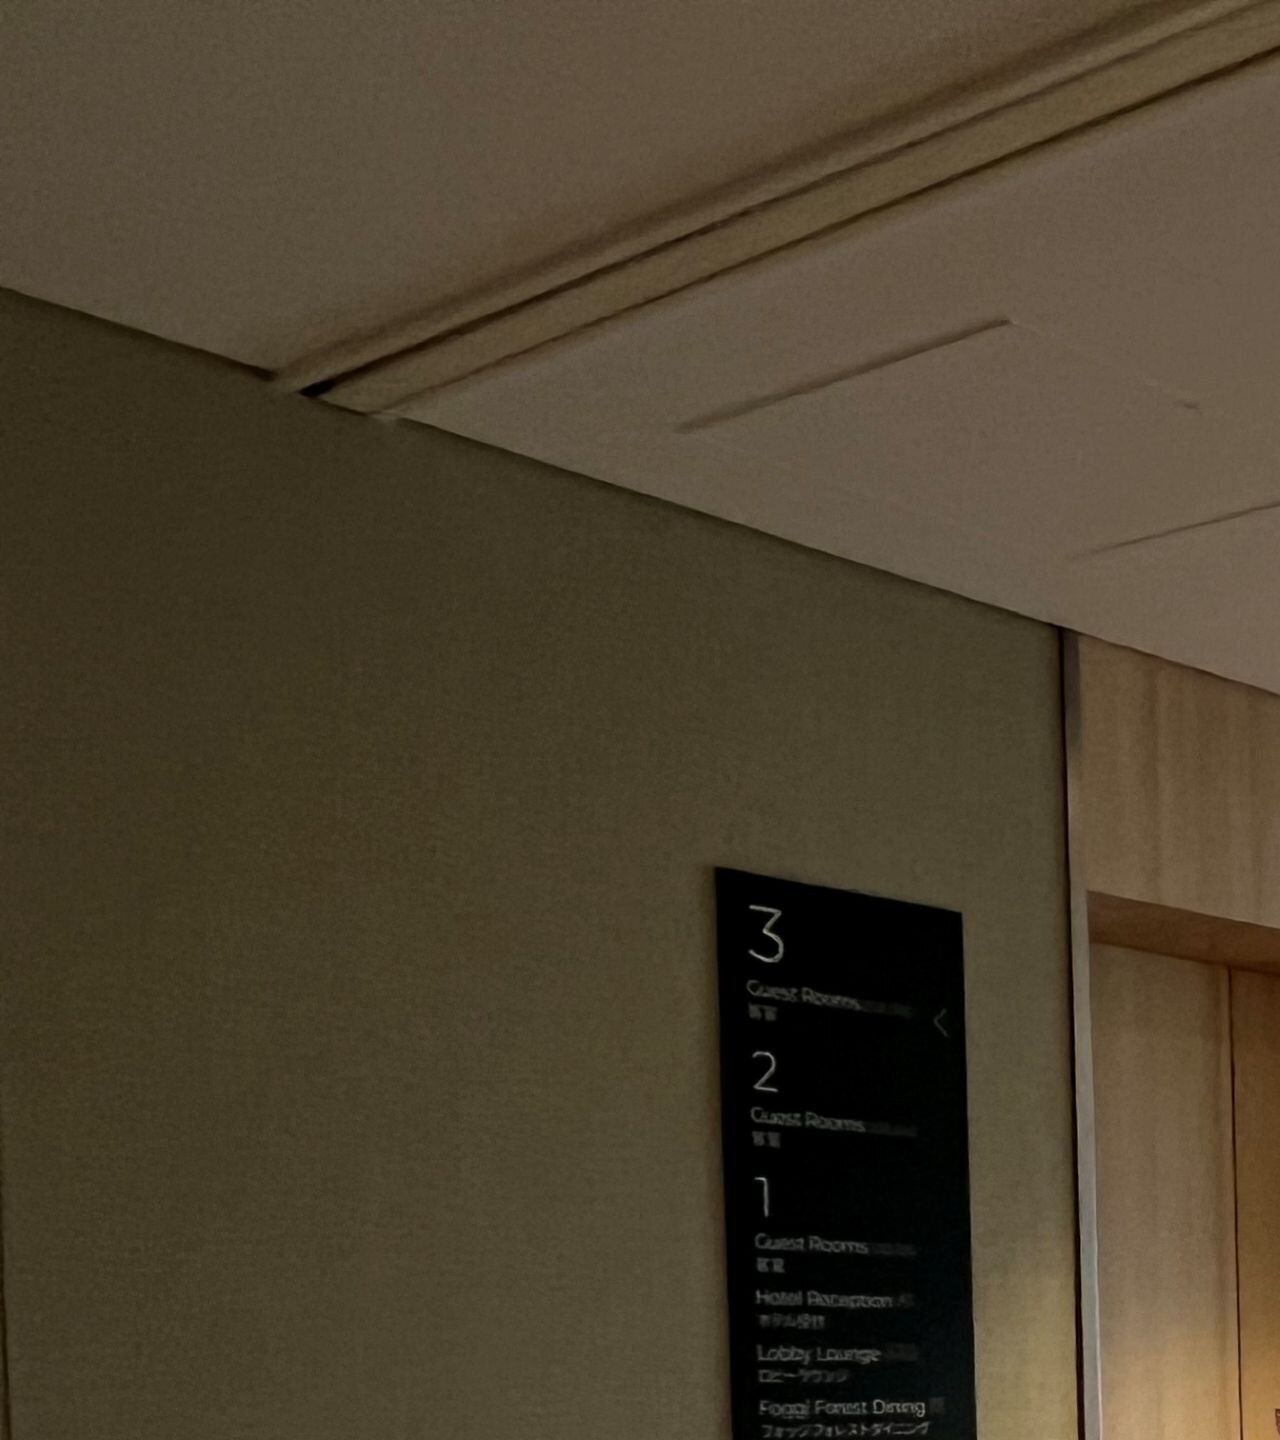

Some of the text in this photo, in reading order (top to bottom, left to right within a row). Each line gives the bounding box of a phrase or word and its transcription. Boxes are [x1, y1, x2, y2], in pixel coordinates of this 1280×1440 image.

[748, 904, 784, 963] 3
[752, 1050, 779, 1093] 2
[754, 1176, 769, 1218] 1
[807, 1235, 868, 1255] Rooms
[756, 1344, 881, 1365] Lobby Lounge
[814, 1398, 866, 1415] Forest
[872, 1398, 926, 1417] Dining
